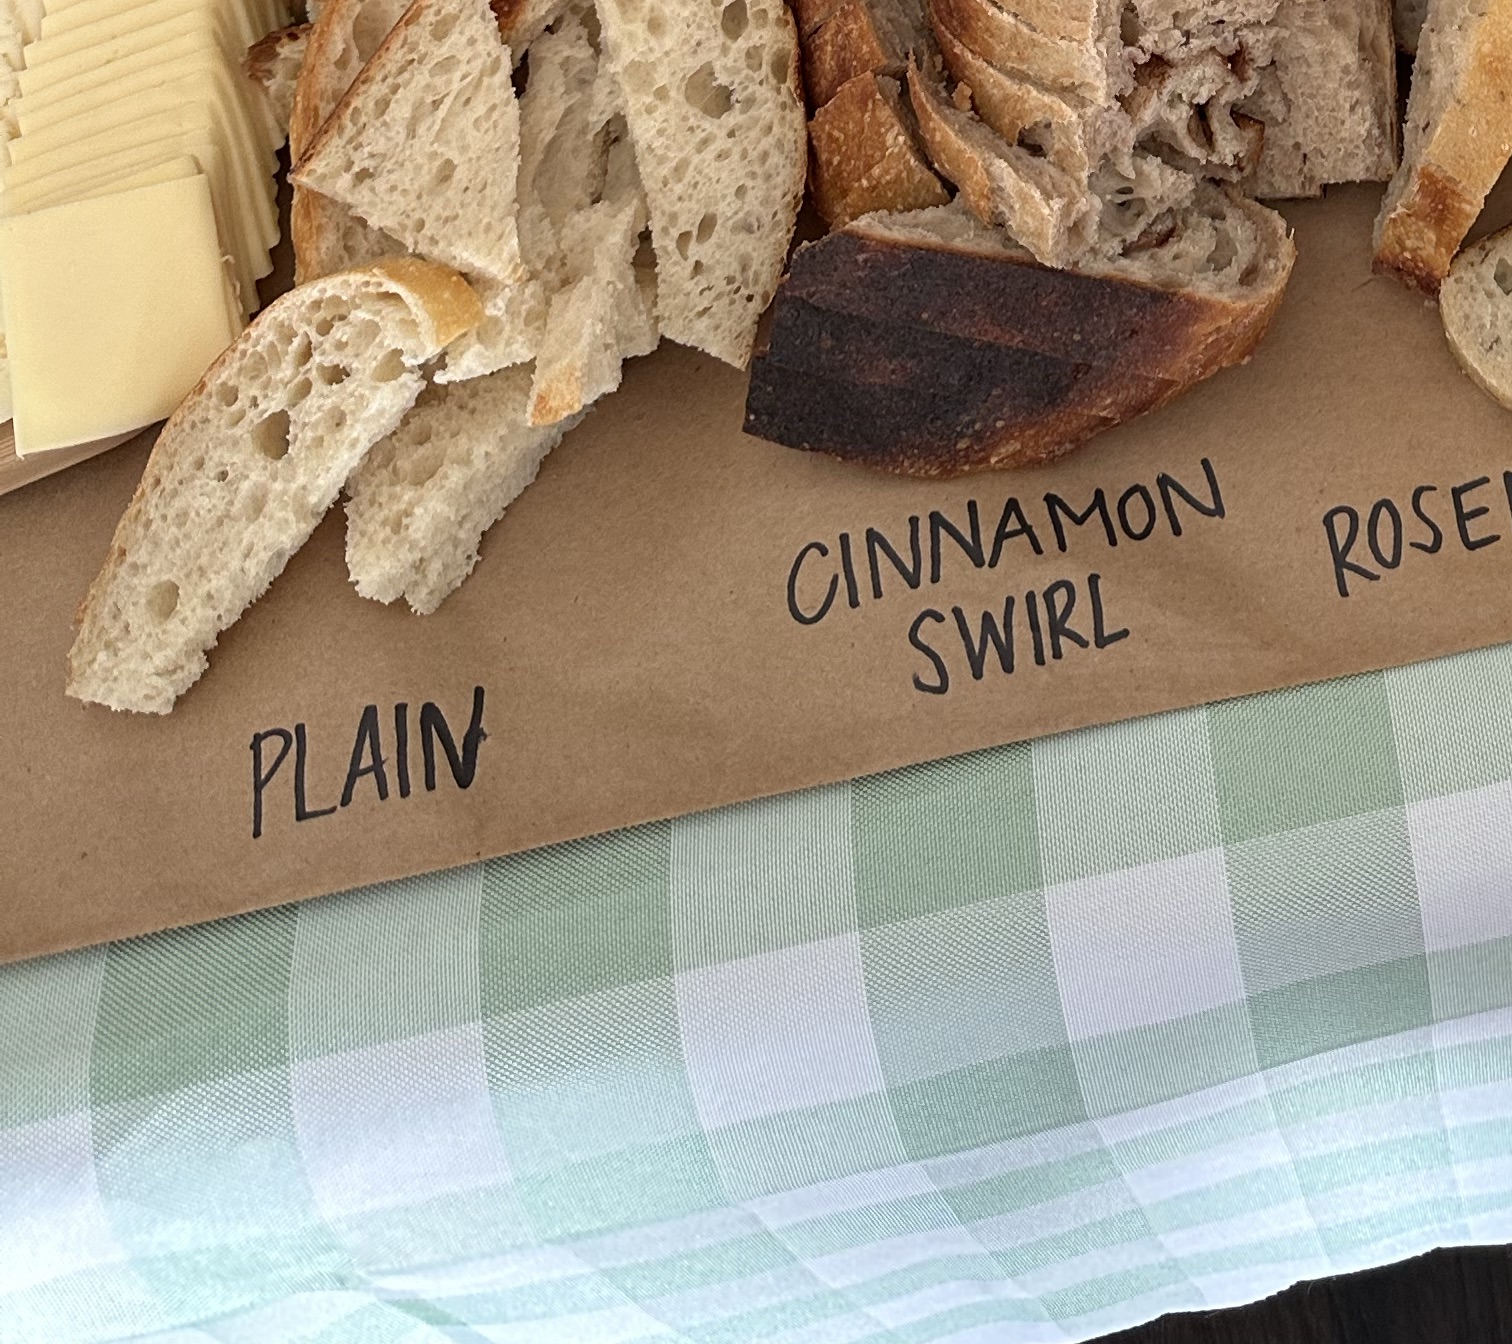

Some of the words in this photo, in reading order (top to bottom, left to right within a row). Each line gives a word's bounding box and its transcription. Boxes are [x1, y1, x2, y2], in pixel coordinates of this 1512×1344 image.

[786, 457, 1227, 626] CINNAMON
[907, 573, 1131, 695] SWIRL
[248, 685, 489, 840] PLAIN
